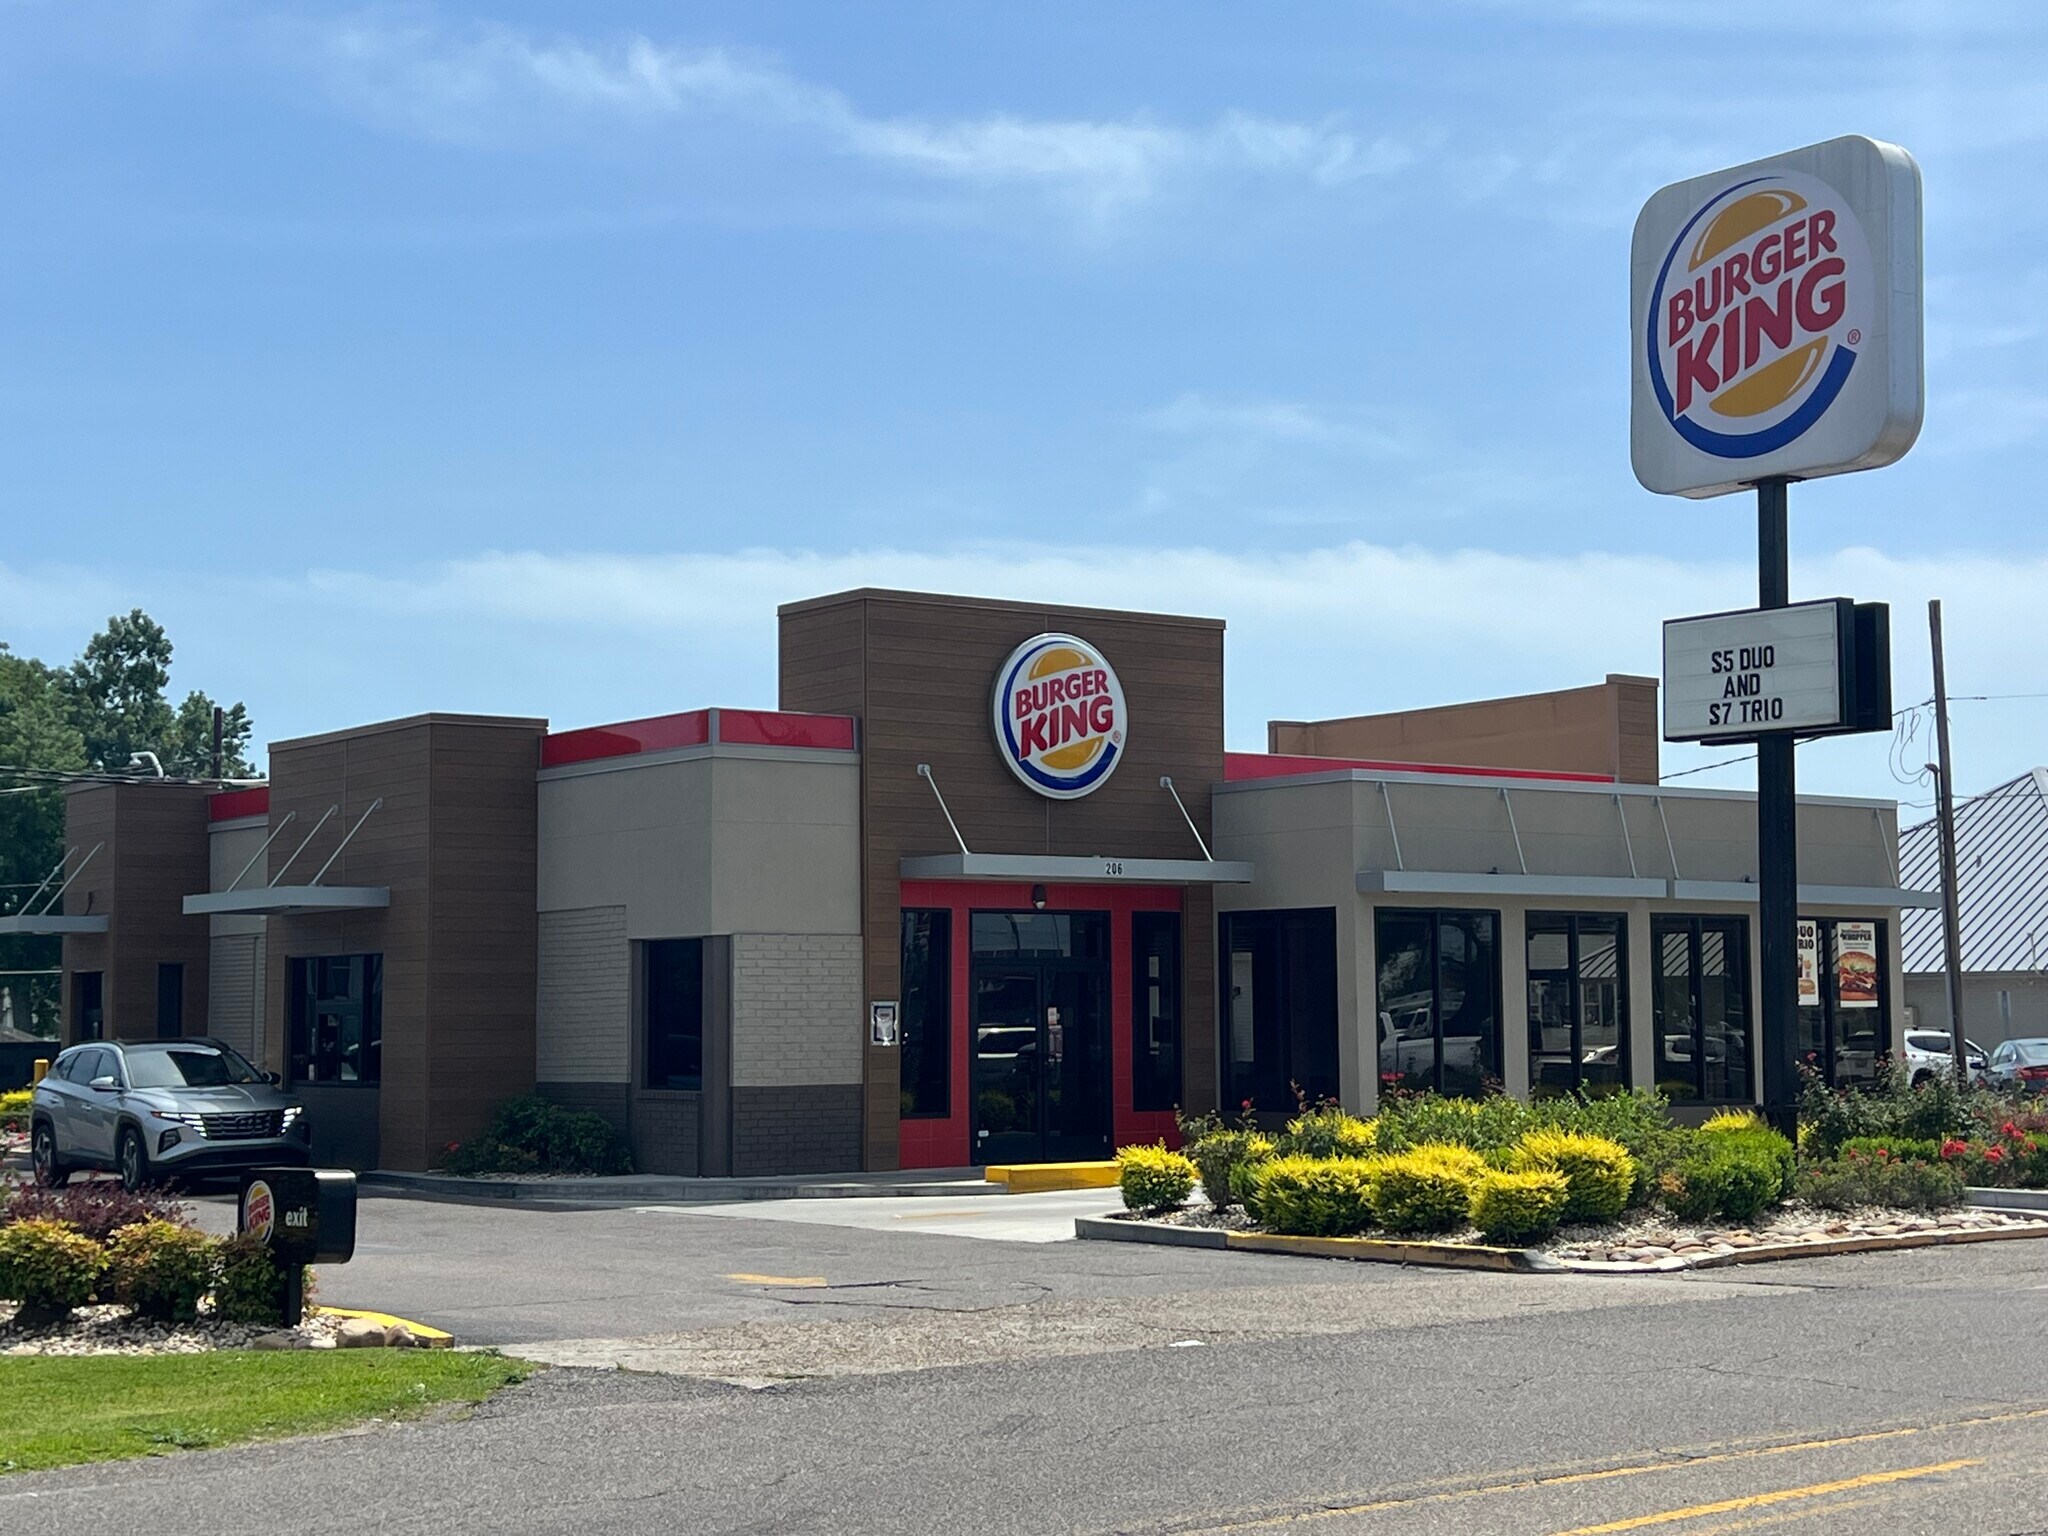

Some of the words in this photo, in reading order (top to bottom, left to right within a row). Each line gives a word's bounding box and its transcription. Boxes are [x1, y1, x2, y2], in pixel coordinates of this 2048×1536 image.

[1669, 209, 1837, 348] BURGER
[1676, 257, 1846, 415] KING
[1740, 645, 1774, 671] DUO
[1016, 669, 1108, 720] BURGER
[1723, 673, 1761, 699] AND
[1740, 697, 1783, 723] TRIO
[1020, 695, 1113, 759] KING
[1105, 862, 1123, 875] 206
[1798, 925, 1814, 938] UO
[285, 1206, 308, 1227] exit
